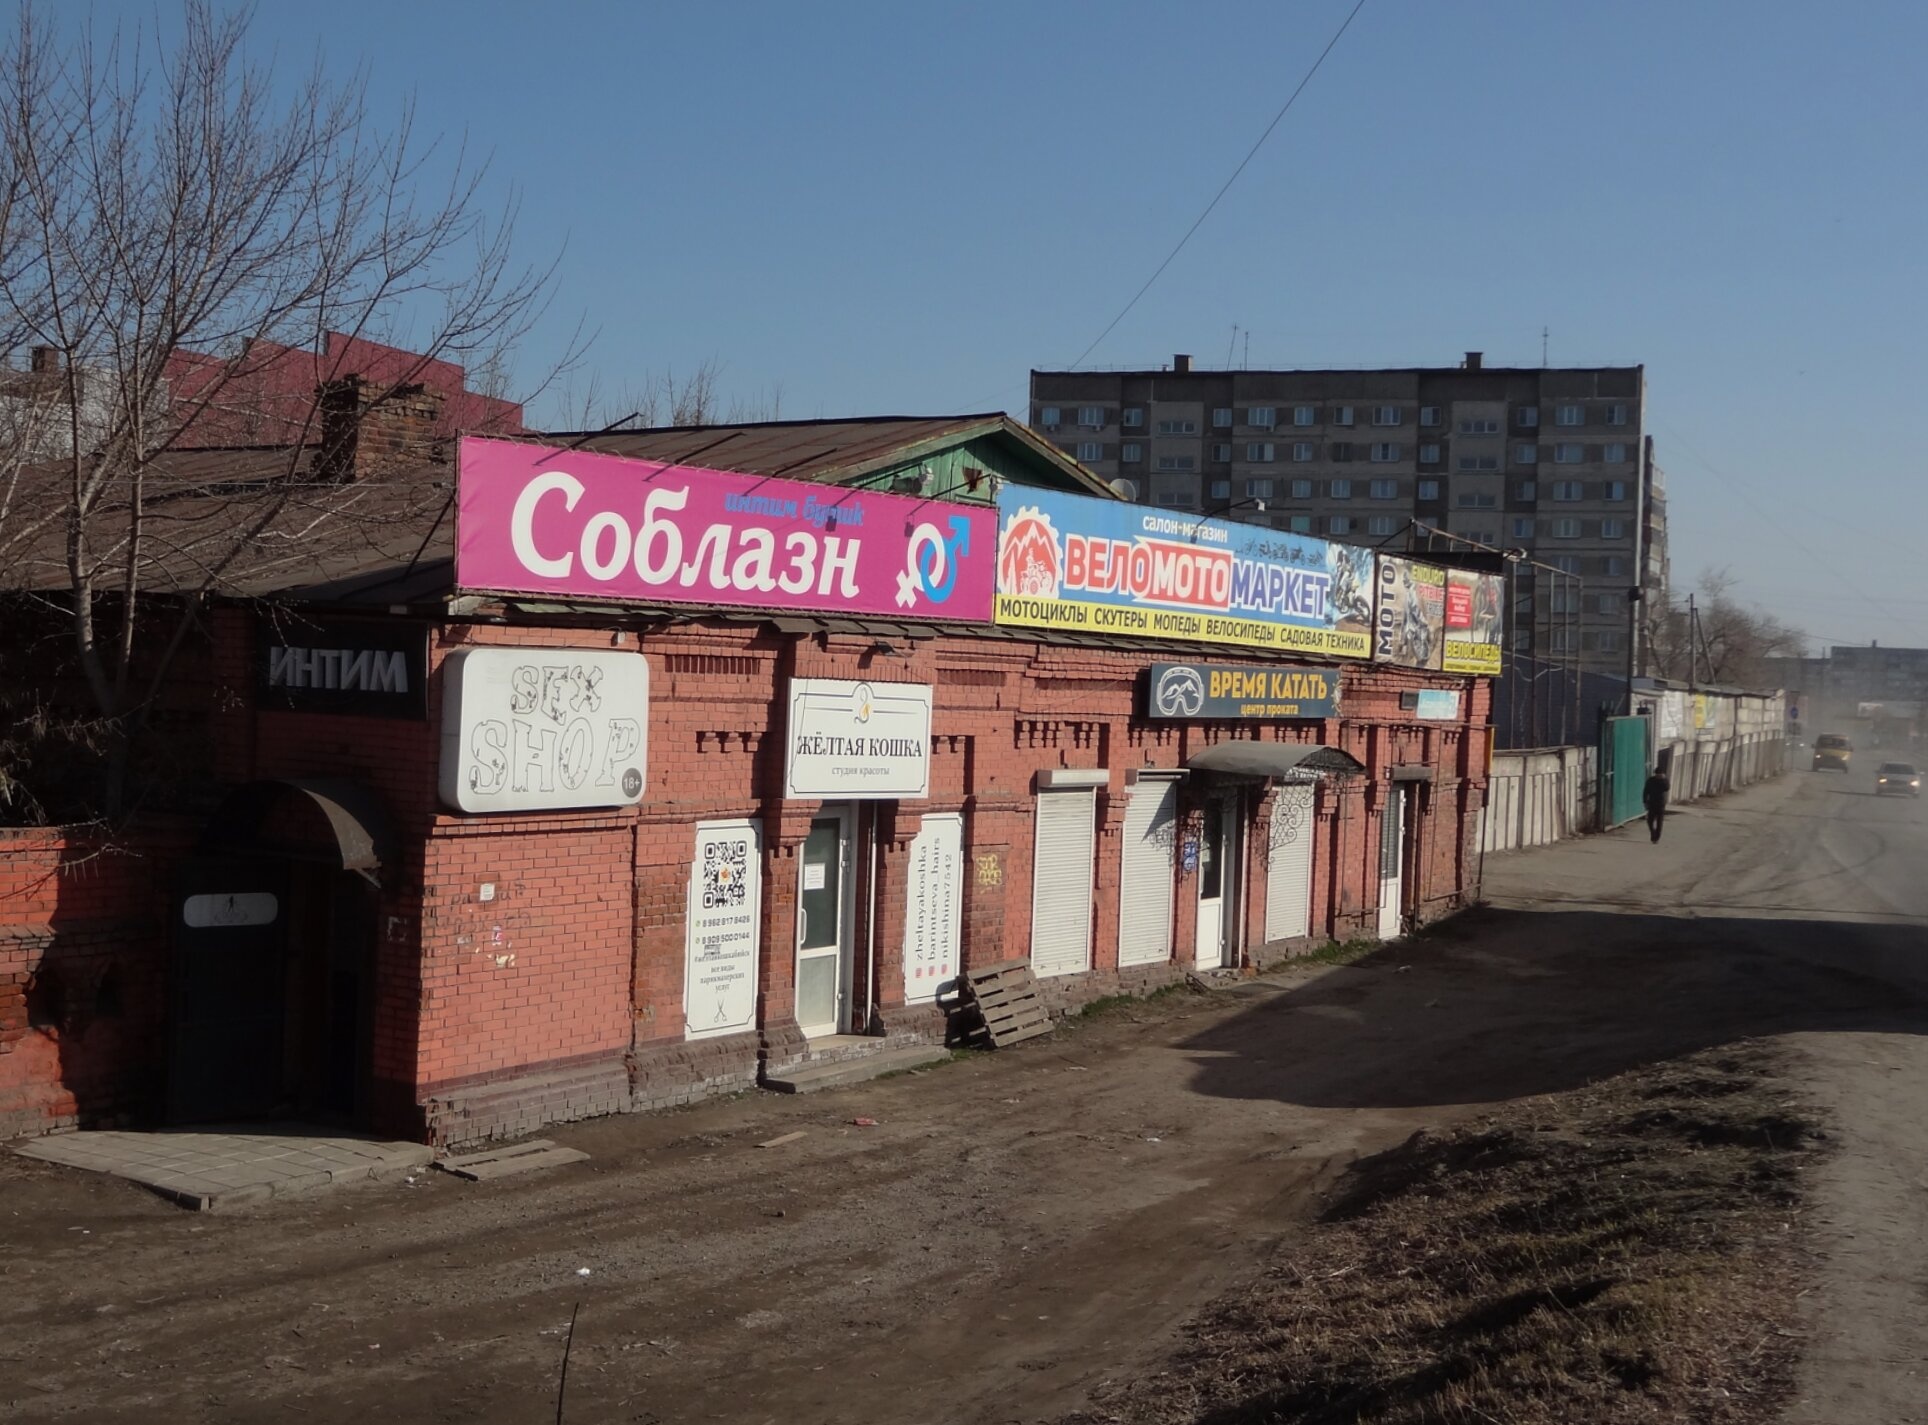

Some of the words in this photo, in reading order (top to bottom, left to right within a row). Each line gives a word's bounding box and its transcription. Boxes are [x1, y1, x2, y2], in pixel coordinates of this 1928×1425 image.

[511, 471, 861, 598] Соблазн
[1142, 515, 1228, 543] салон-магазин
[1412, 564, 1445, 586] ENDURO
[1001, 598, 1087, 623] МОТОЦИКЛЫ
[1094, 607, 1147, 629] СКУТЕРЫ
[1154, 614, 1200, 635] МОПЕДЫ
[1206, 620, 1275, 643] ВЕЛОСИПЕДЫ
[1280, 628, 1323, 647] САДОВАЯ
[1326, 633, 1365, 651] ТЕХНИКА
[1378, 564, 1395, 655] МОТО
[269, 646, 408, 693] ИНТИМ
[1209, 671, 1267, 698] ВРЕМЯ
[1271, 673, 1328, 699] КАТАТЬ
[510, 665, 604, 726] SEX
[1240, 703, 1265, 716] центр
[1266, 704, 1298, 717] проката
[469, 717, 640, 795] SHOP
[797, 731, 864, 756] ЖЁЛТАЯ
[869, 738, 922, 757] КОШКА
[623, 776, 640, 790] 18+
[831, 767, 858, 777] студия
[859, 767, 890, 778] красоты
[915, 845, 927, 961] zheltayakoshka
